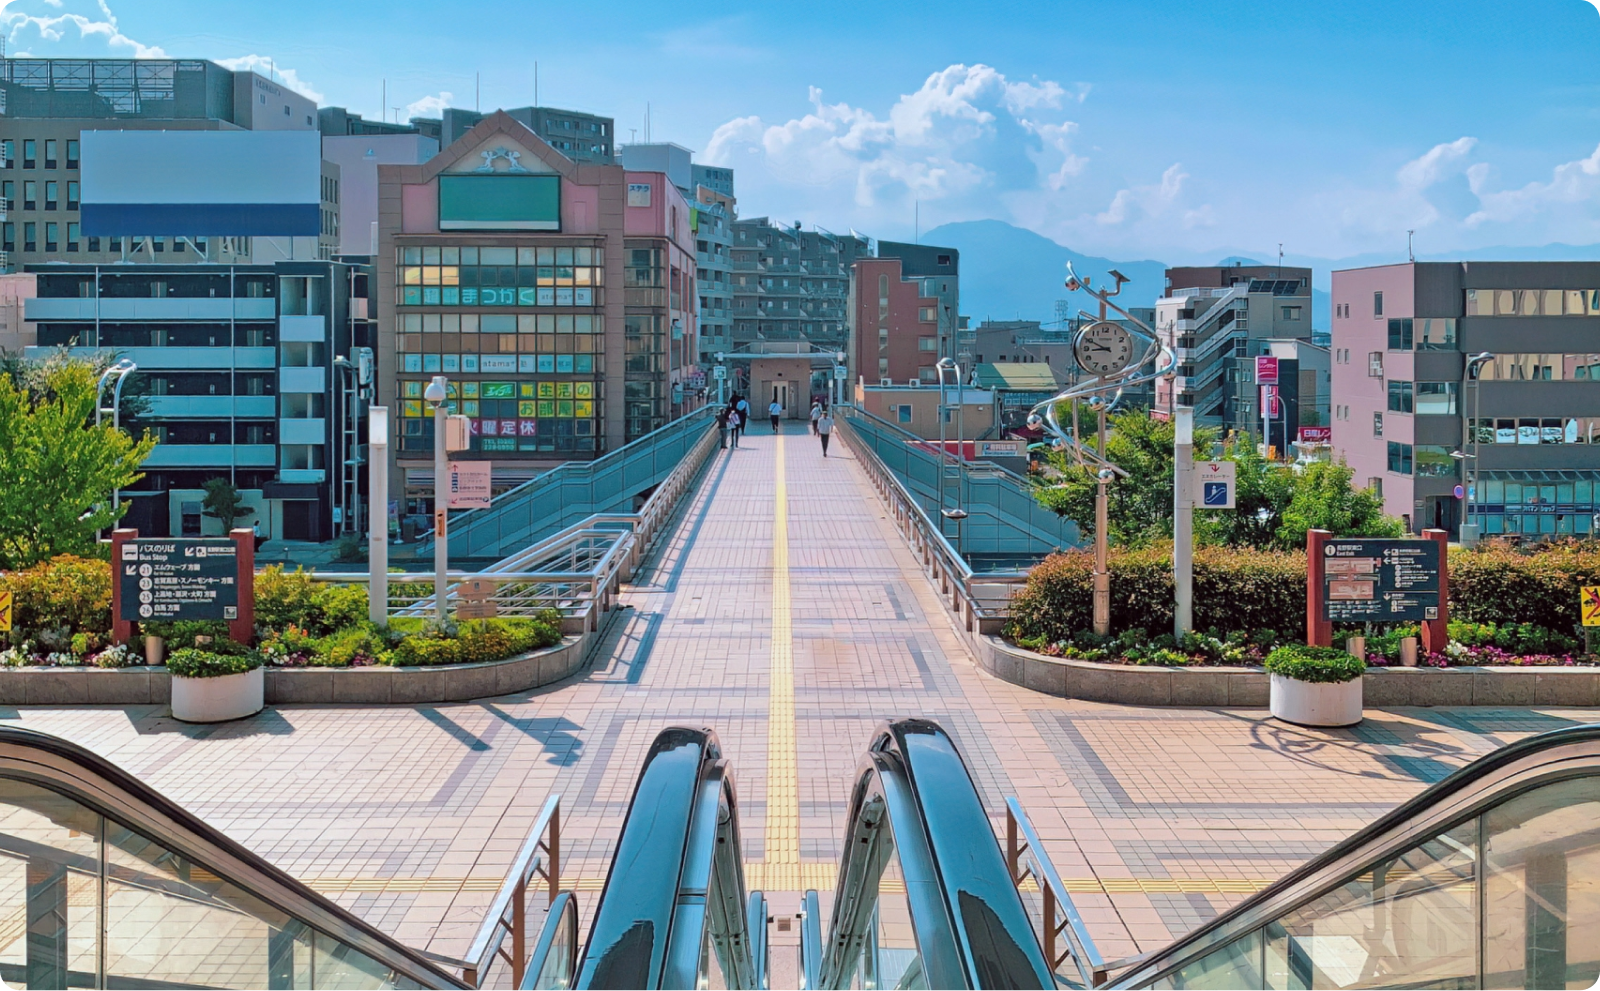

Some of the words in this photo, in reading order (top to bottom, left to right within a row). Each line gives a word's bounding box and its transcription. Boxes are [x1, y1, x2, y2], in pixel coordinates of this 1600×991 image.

[521, 383, 590, 397] 新生活の
[140, 544, 175, 552] バスのりば
